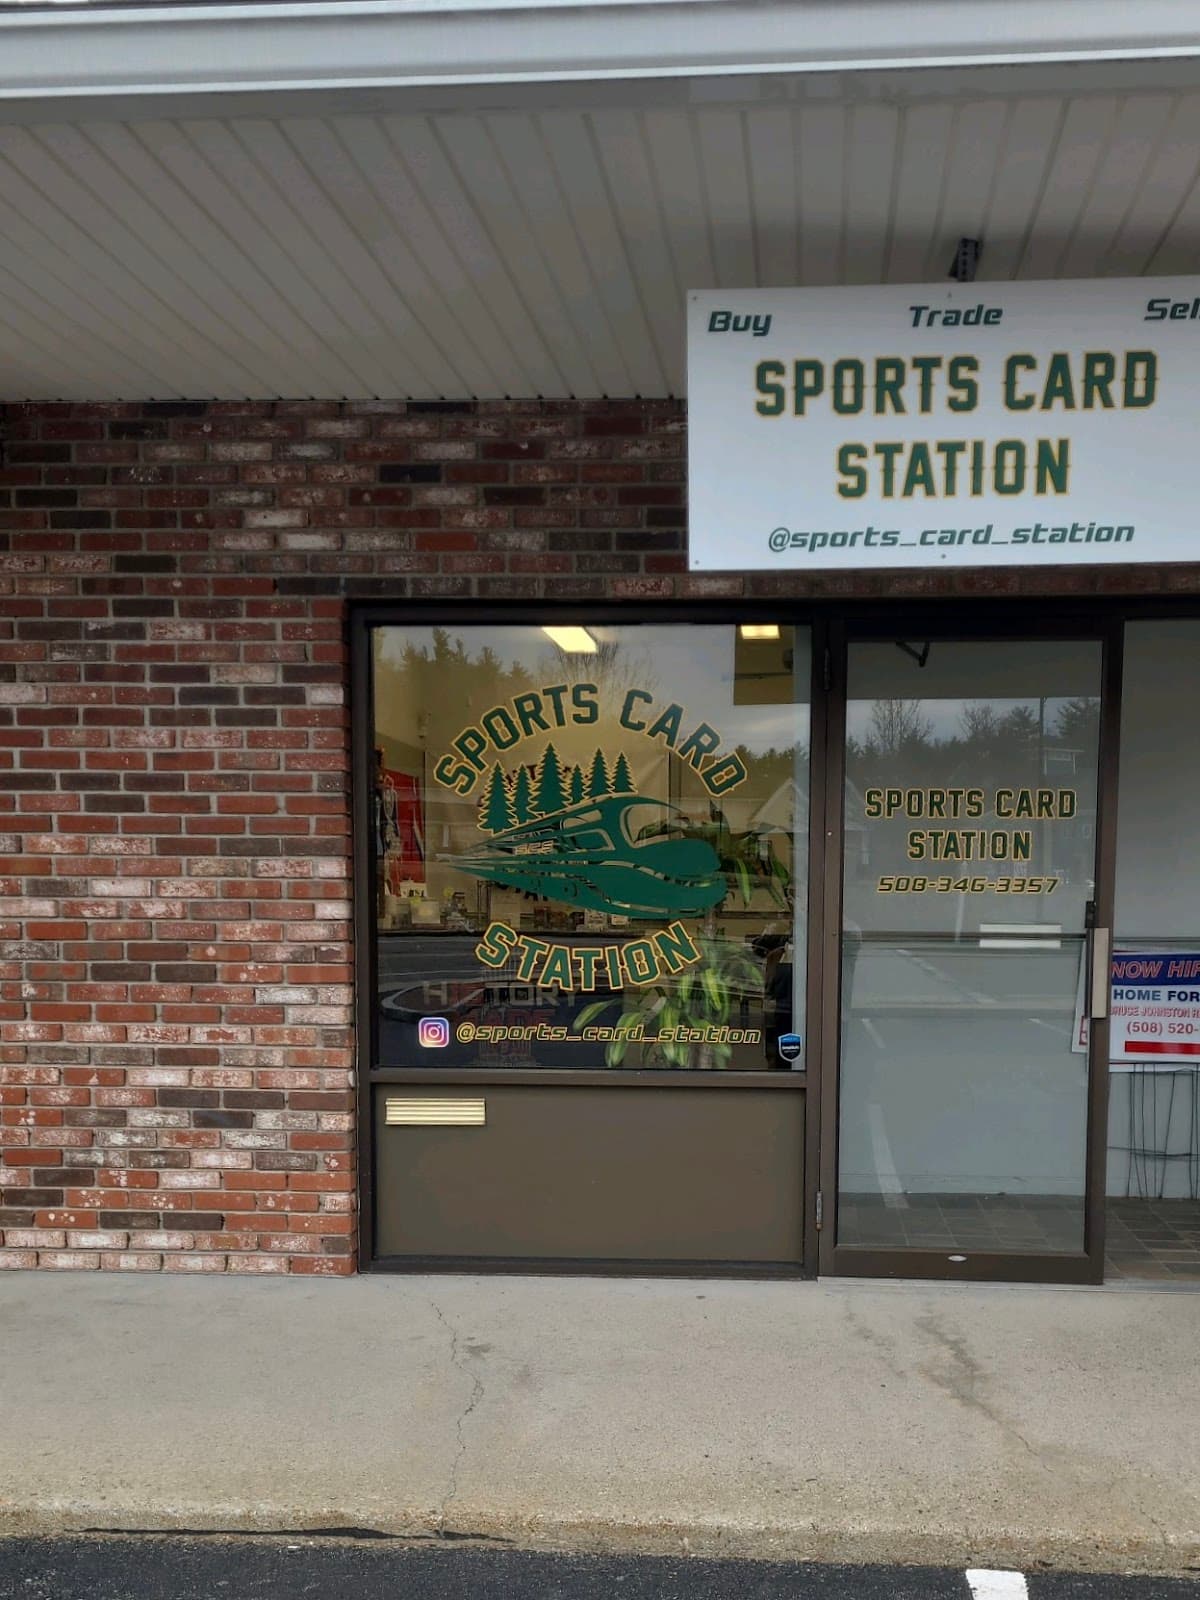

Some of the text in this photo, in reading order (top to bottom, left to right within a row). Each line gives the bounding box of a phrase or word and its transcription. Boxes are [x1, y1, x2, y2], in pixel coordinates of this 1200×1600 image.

[708, 297, 1200, 336] Buy Trade Sel
[754, 349, 1159, 418] SPORTS CARD
[836, 437, 1072, 500] STATION
[768, 522, 1134, 553] @sports_card_station
[433, 682, 748, 798] SPORTS CARD
[865, 788, 1077, 820] SPORTS CARD
[907, 830, 1032, 861] STATION
[877, 876, 1060, 894] 508-346-3357
[475, 920, 702, 992] STATION
[1111, 960, 1162, 979] NOW
[1113, 989, 1161, 1001] HOME
[456, 1021, 762, 1044] @sports_card_station
[1127, 1022, 1163, 1035] (508)
